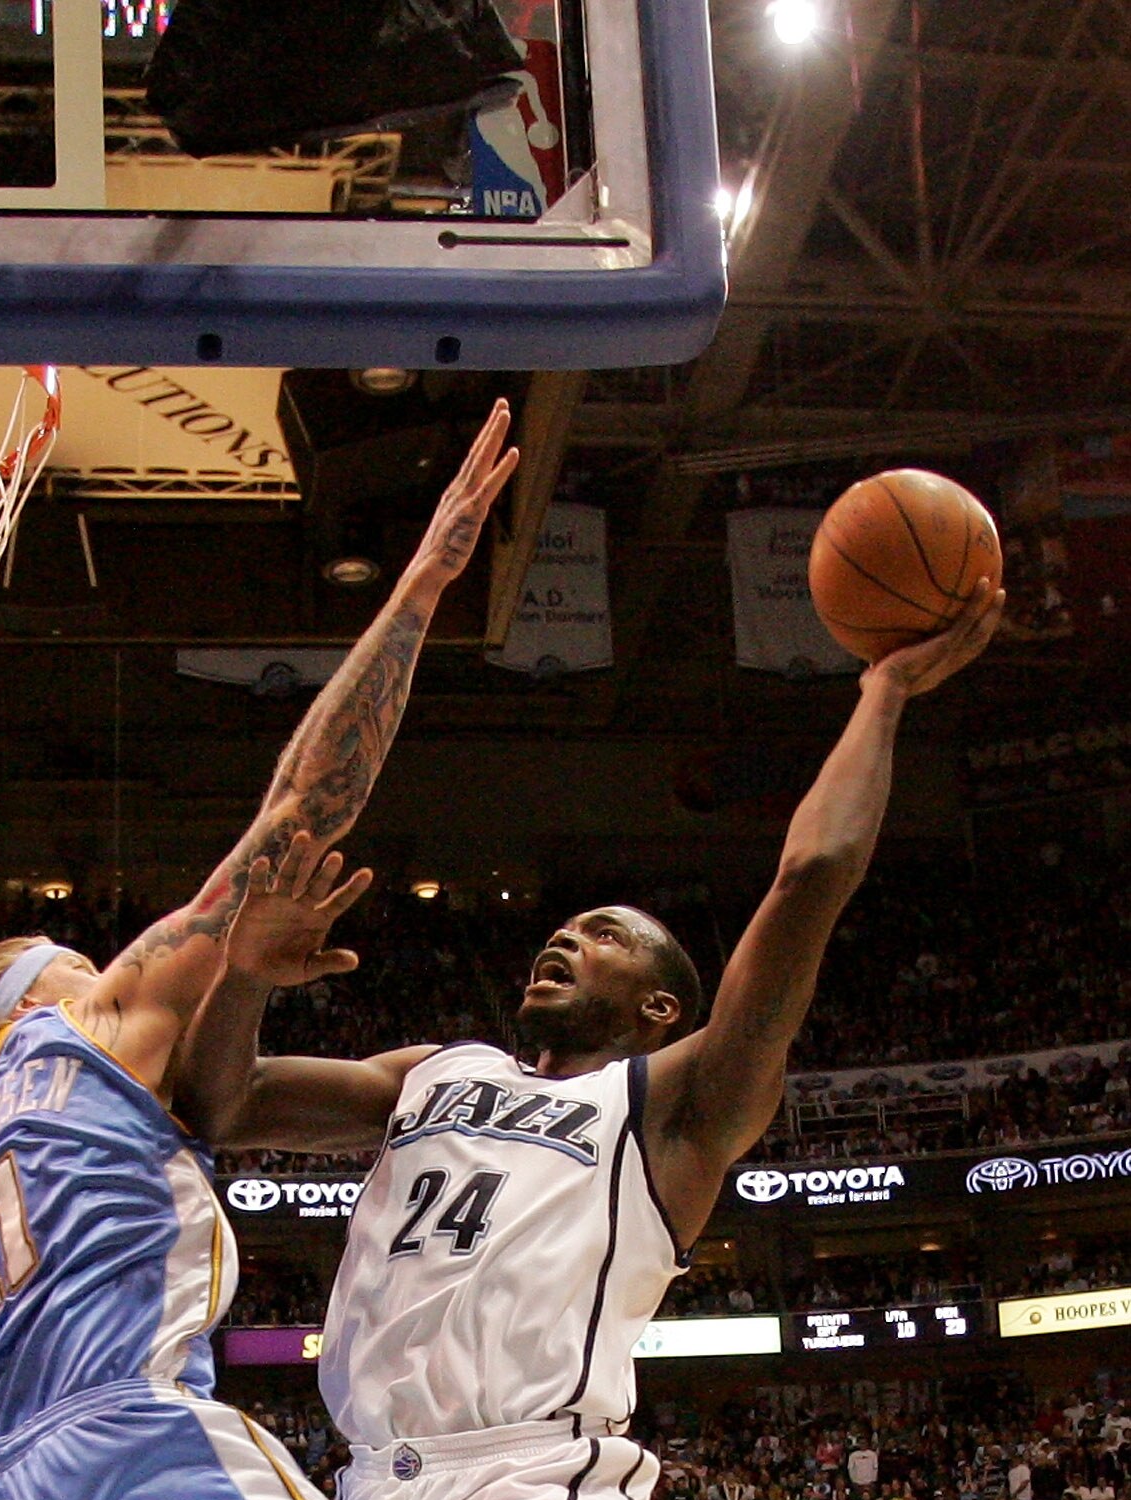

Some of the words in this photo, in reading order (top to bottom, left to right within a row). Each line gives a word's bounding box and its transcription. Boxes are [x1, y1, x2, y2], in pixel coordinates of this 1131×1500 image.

[483, 189, 536, 216] NBA
[389, 1077, 601, 1166] JAZZ
[788, 1165, 905, 1193] TOYOTA
[281, 1182, 365, 1204] TOYO
[388, 1166, 511, 1263] 24
[1055, 1301, 1117, 1322] HOOPES
